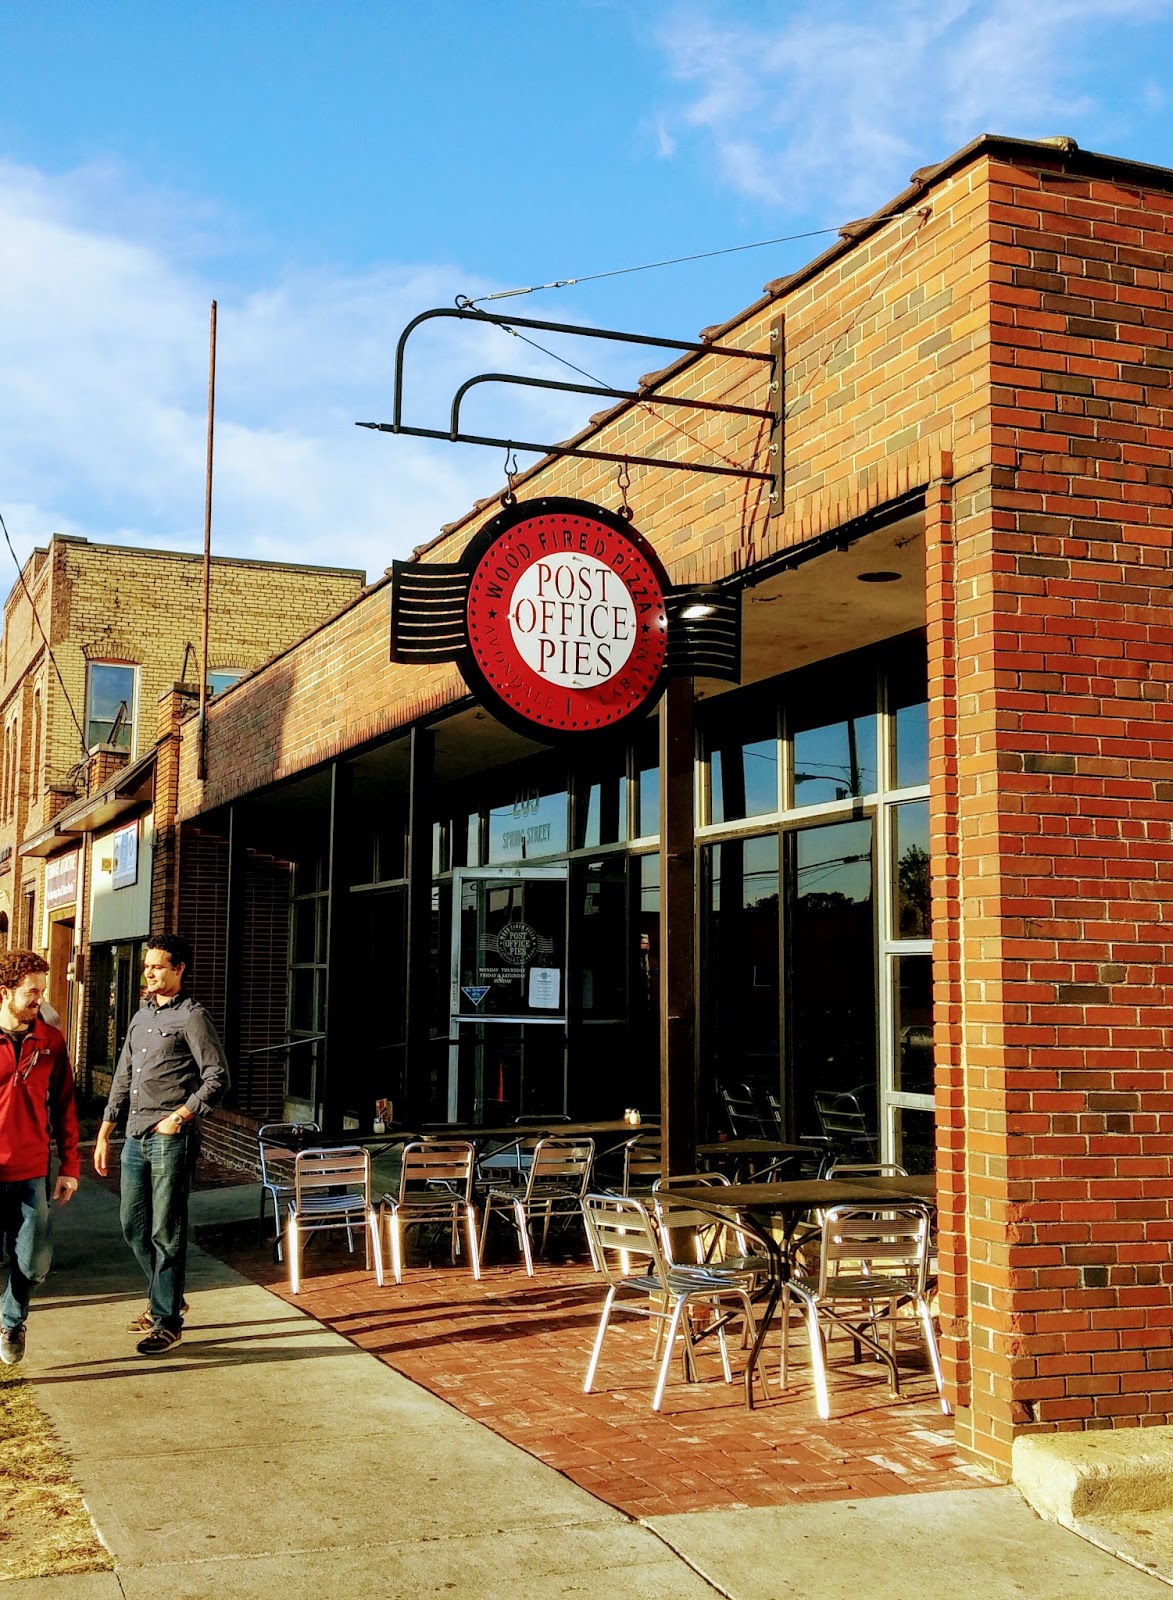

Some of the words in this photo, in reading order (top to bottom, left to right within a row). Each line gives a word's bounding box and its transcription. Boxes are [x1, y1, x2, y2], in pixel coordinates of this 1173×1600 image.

[485, 543, 531, 599] WOOD
[538, 530, 606, 556] FIRED
[611, 553, 653, 614] PIZZA
[536, 563, 612, 602] POST
[515, 598, 630, 641] OFFICE
[537, 638, 612, 677] PIES
[526, 823, 551, 845] STREET
[504, 940, 531, 948] OFFICE
[509, 931, 527, 940] POST
[509, 947, 527, 956] PIES
